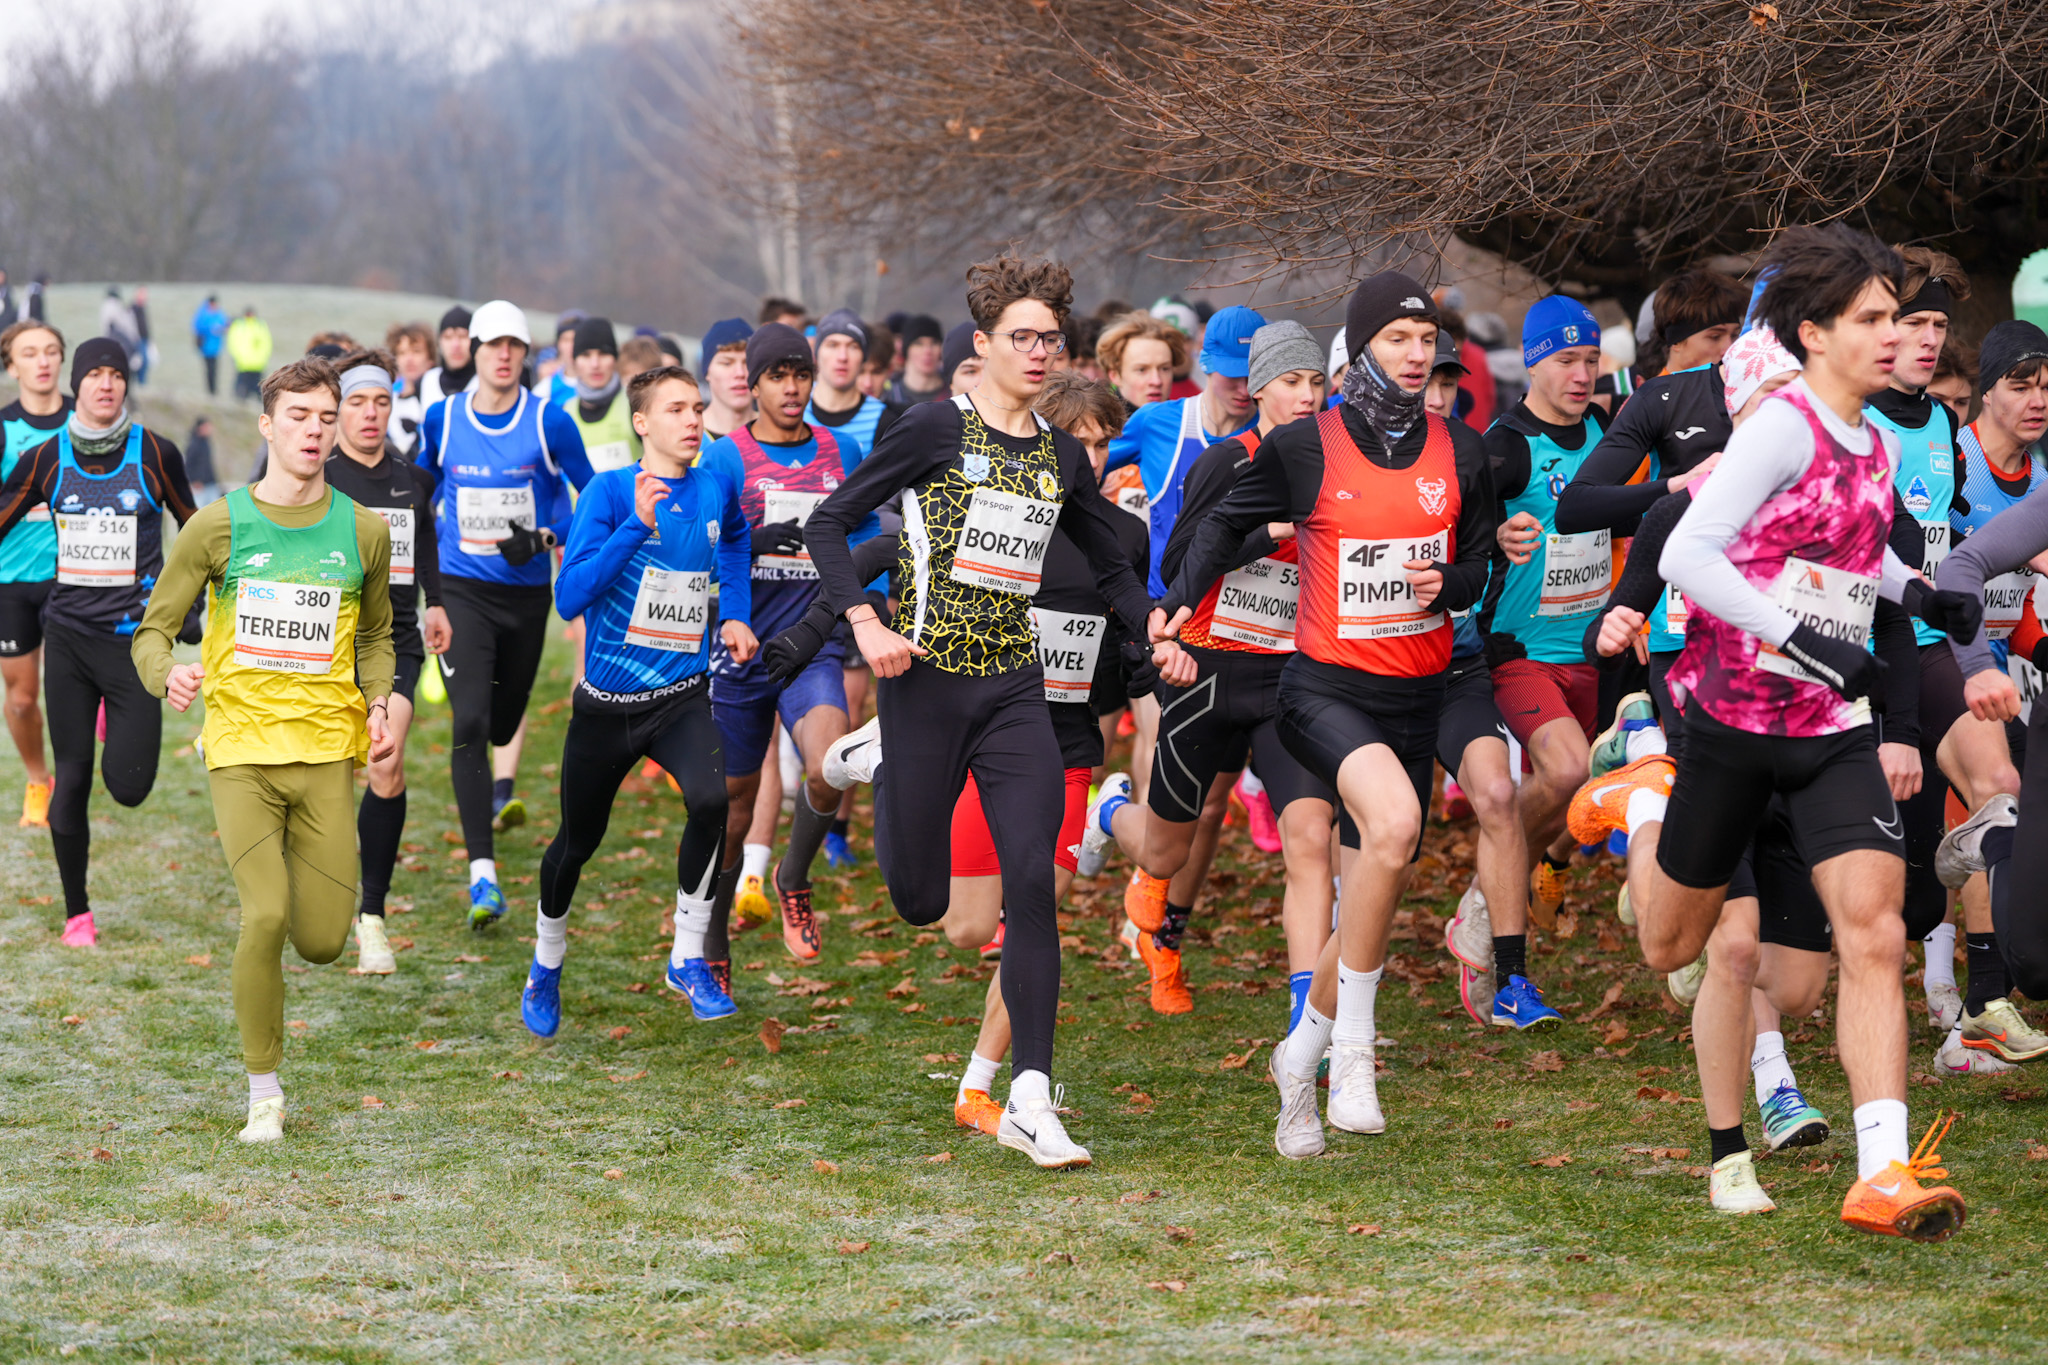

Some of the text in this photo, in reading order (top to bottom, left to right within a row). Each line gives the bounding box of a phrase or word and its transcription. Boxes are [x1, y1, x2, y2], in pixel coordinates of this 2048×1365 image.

[1525, 339, 1548, 360] GRANIT
[1005, 459, 1024, 471] esa
[501, 491, 528, 506] 235
[974, 498, 1013, 512] TVP SPORT
[1023, 504, 1055, 527] 262
[99, 520, 128, 534] 516
[61, 544, 131, 560] JASZCZYK
[391, 541, 410, 557] ZEK
[964, 527, 1045, 562] BORZYM
[1407, 539, 1441, 562] 188
[245, 553, 273, 567] 4F
[1347, 543, 1390, 567] 4F
[751, 567, 781, 579] MKL
[1279, 568, 1299, 587] 53
[688, 577, 707, 592] 424
[978, 576, 1022, 591] LUBIN 2025
[295, 589, 330, 608] 380
[1848, 582, 1875, 607] 493
[1985, 588, 2025, 609] WALSKI
[648, 602, 703, 623] WALAS
[1563, 600, 1600, 612] LUBIN 2025
[239, 614, 330, 642] TEREBUN
[1062, 619, 1096, 637] 492
[1371, 622, 1425, 636] LUBIN 2025
[649, 640, 691, 650] LUBIN 2025
[1233, 631, 1278, 647] LUBIN 2025
[257, 658, 306, 670] LUBIN 2025
[1043, 647, 1085, 671] WEŁ
[581, 681, 612, 702] PRO
[611, 691, 650, 703] NIKE
[652, 681, 688, 699] PRO
[688, 673, 701, 687] NI
[1047, 690, 1068, 699] 2025
